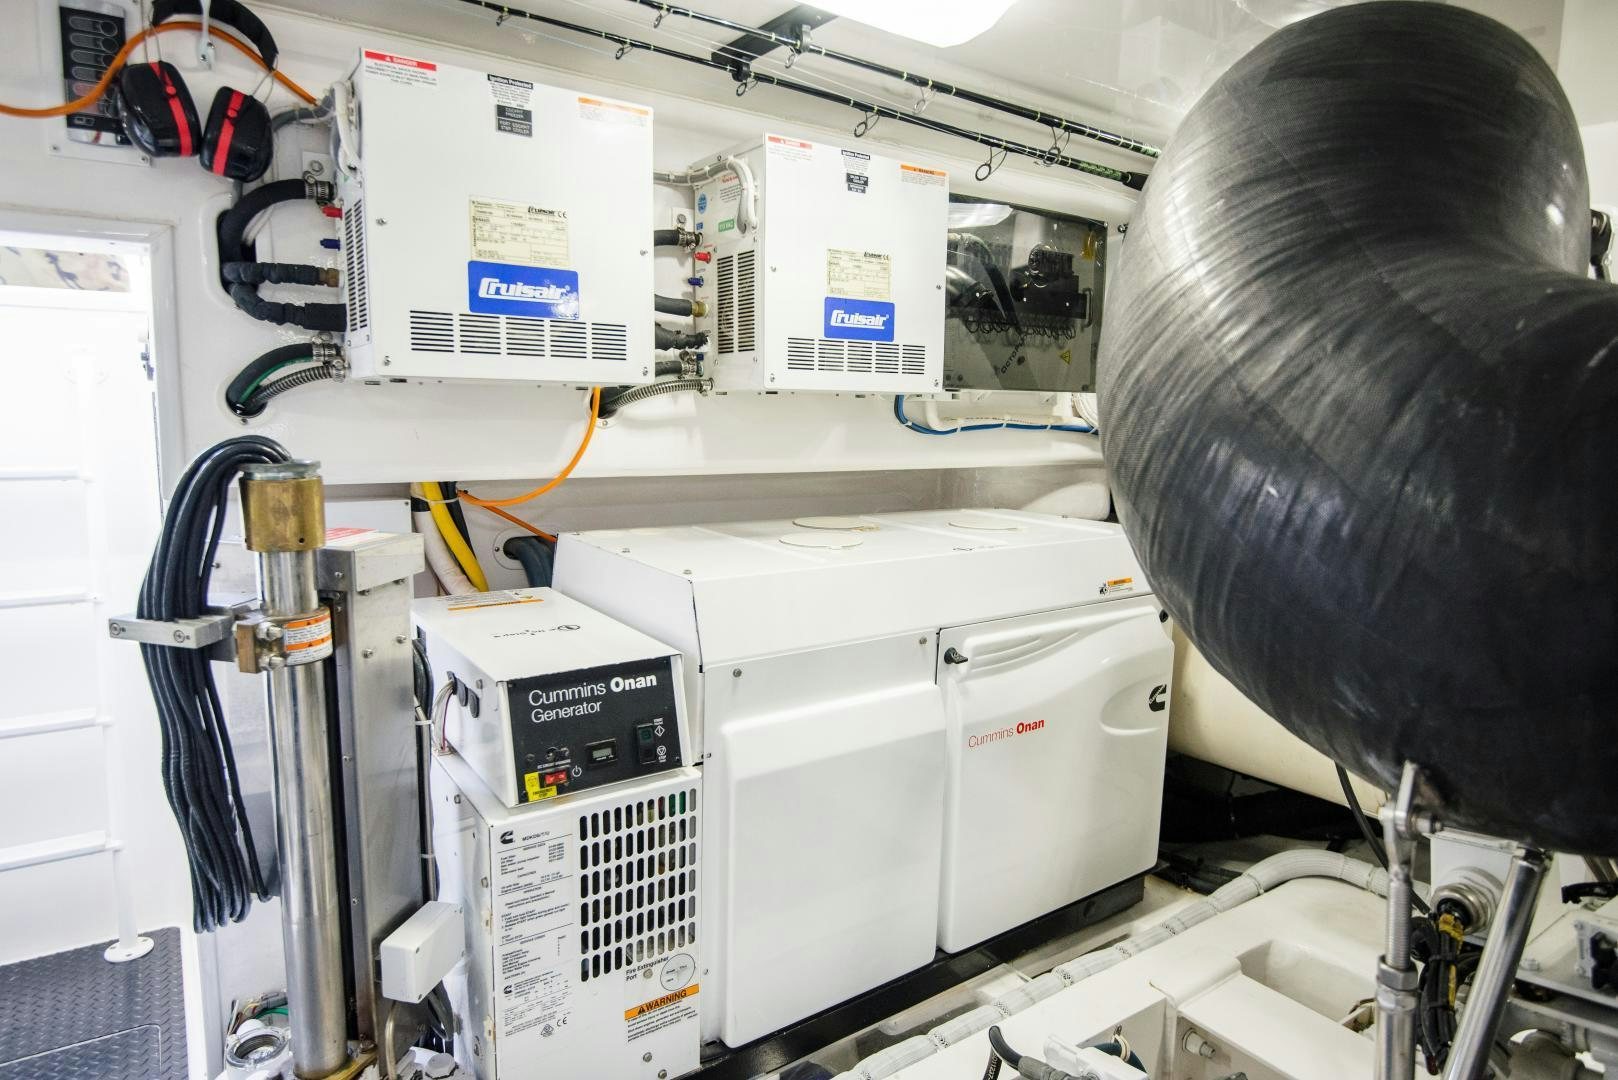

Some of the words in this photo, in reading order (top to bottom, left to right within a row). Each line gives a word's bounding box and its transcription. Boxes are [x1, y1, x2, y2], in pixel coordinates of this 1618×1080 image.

[478, 277, 568, 303] Cruisair
[830, 309, 888, 330] Cruisair
[528, 682, 606, 706] Cummins
[610, 674, 657, 693] Onan
[531, 701, 602, 723] Generator
[968, 727, 1014, 748] Cummins
[1016, 719, 1045, 735] Onan
[626, 967, 637, 976] Fire
[637, 956, 669, 971] Extinguisher
[626, 973, 637, 981] Port
[646, 989, 687, 1011] WARNING
